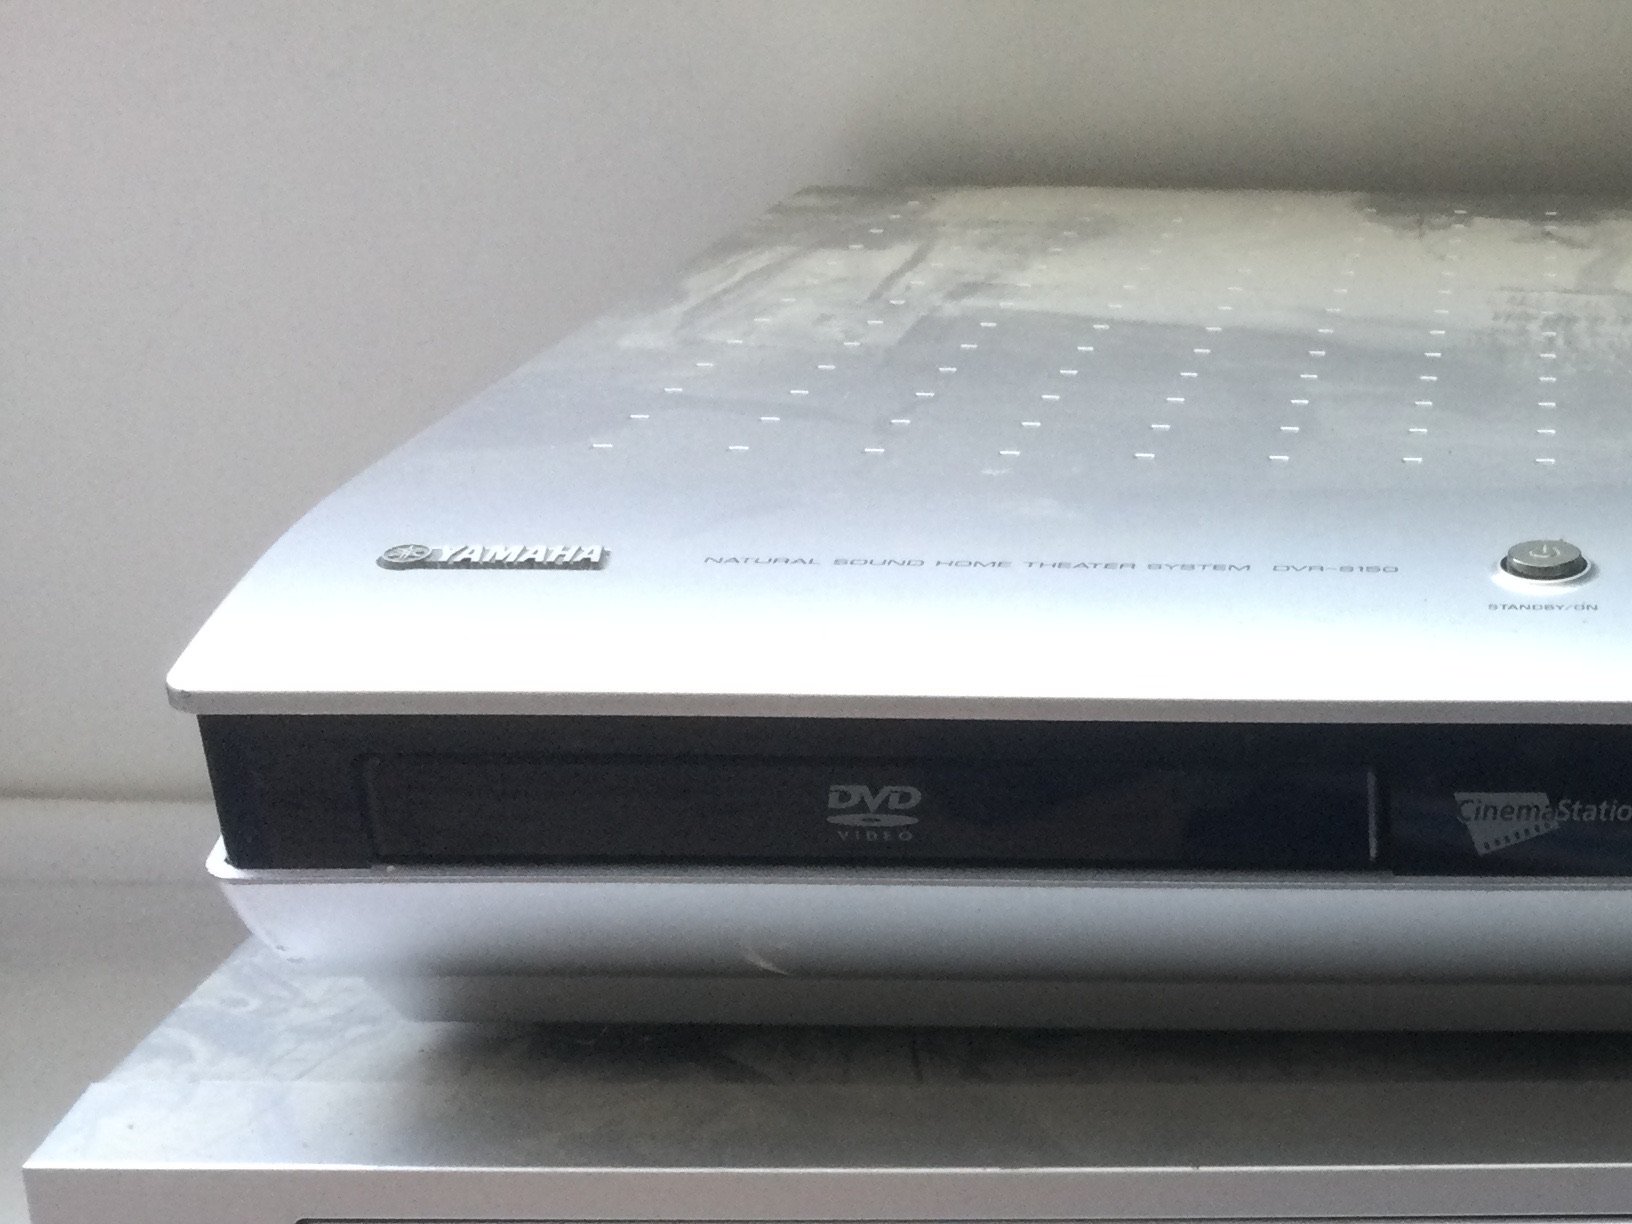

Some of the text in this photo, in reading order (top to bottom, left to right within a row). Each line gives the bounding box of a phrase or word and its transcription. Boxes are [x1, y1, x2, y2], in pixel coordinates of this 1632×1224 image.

[436, 543, 606, 569] YAMAHA
[704, 556, 820, 566] NATURAL
[833, 558, 925, 567] SOUND
[935, 559, 1013, 569] HOME
[1025, 561, 1137, 570] THEATER
[1147, 563, 1252, 572] SYSTEM
[1488, 602, 1599, 612] STANDBY/ON
[828, 784, 922, 812] DVD
[837, 830, 913, 842] VIDEO
